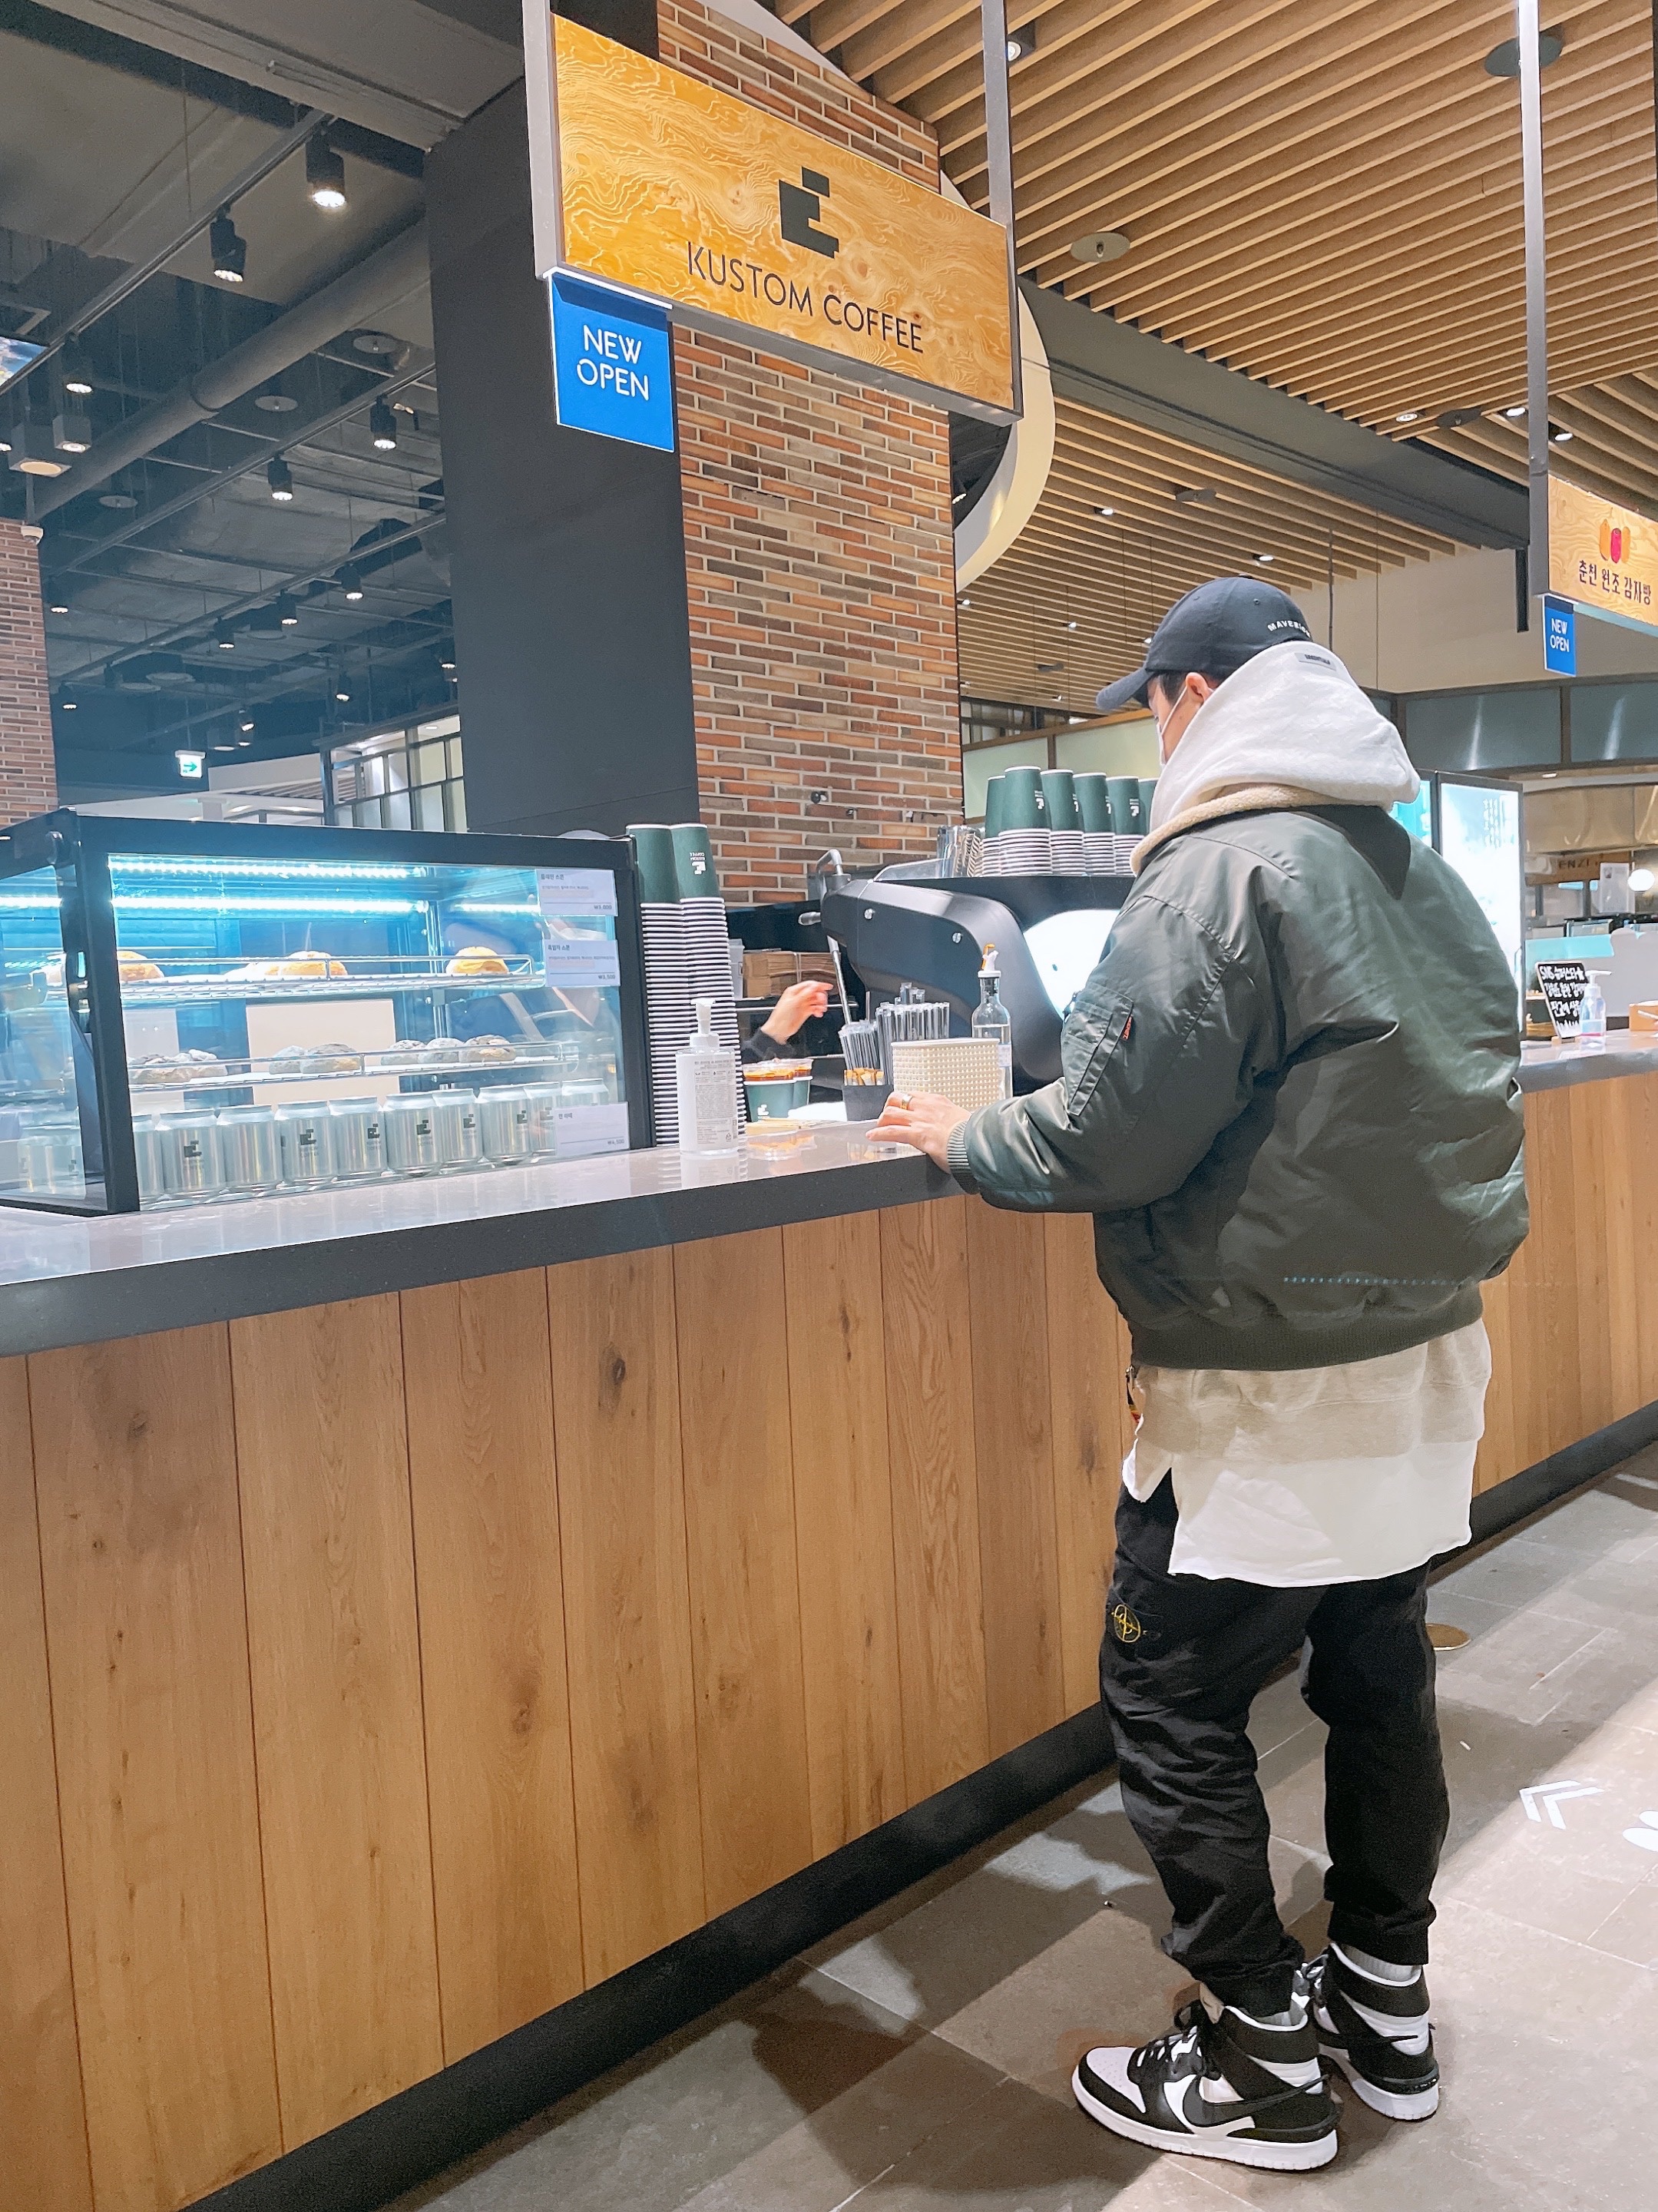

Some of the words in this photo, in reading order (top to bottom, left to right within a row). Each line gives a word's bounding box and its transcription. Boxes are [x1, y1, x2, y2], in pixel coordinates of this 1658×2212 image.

[687, 241, 813, 316] KUSTOM
[823, 294, 924, 353] COFFEE
[584, 324, 642, 364] NEW
[577, 358, 649, 401] OPEN
[1579, 560, 1597, 586] 춘천
[1602, 568, 1620, 594] 원조
[1624, 576, 1651, 605] 감자빵
[1550, 634, 1570, 652] OPEN
[1551, 618, 1568, 634] NEW
